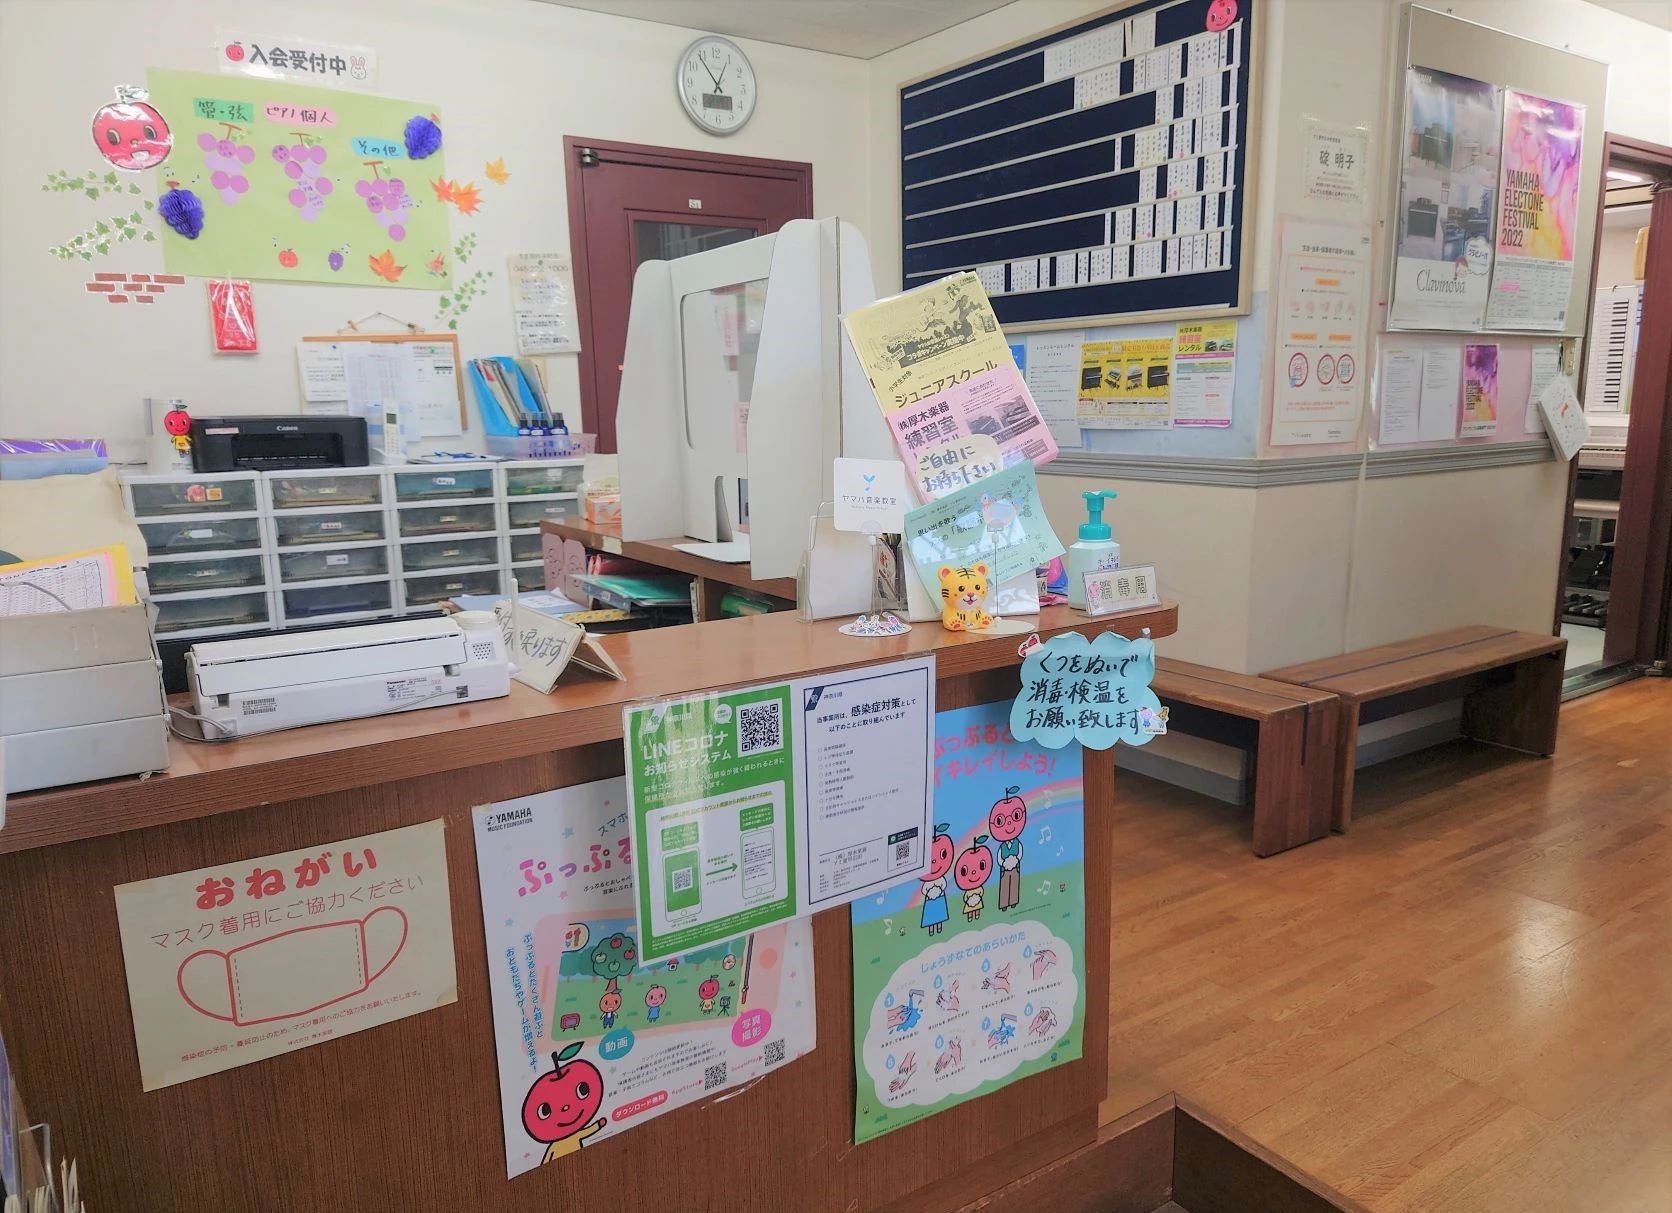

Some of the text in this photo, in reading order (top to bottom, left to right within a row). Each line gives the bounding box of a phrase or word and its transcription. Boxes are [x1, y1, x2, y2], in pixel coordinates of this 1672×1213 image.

[248, 42, 348, 77] 入会受付中
[357, 139, 399, 157] その他
[1335, 153, 1354, 169] 明子
[1506, 168, 1540, 192] YAMAHA
[1504, 189, 1544, 213] ELECTONE
[1502, 209, 1539, 230] FESTIVAL
[1501, 228, 1523, 248] 2022
[1416, 269, 1466, 295] Clavinova
[1178, 344, 1201, 352] レンタル
[889, 370, 913, 392] 小学生対象
[895, 360, 998, 408] ジュニアスクール
[276, 425, 299, 433] Canon
[905, 415, 959, 450] 練習室
[919, 444, 976, 470] ご自由に
[842, 495, 897, 505] ヤマハ音楽教室
[1039, 652, 1139, 677] くつをぬいで
[1026, 678, 1130, 705] 消毒・検温を
[817, 697, 917, 724] 当事業所は、感染症対策として
[828, 711, 906, 733] 以下のことに取り組んでいます
[1026, 705, 1140, 735] お願い致します
[643, 730, 729, 760] LINEコロナ
[644, 750, 732, 777] お知らせシステム
[487, 817, 533, 832] MUSIC FOUNDATION
[496, 807, 532, 823] YAMAHA
[518, 837, 631, 897] ぷっぷる
[195, 848, 377, 911] おねがい
[151, 875, 424, 949] マスク着用にご協力ください
[921, 931, 1026, 974] じょうずなてのあらいかた
[742, 1014, 762, 1030] 写真
[605, 1036, 629, 1054] 動画
[742, 1027, 762, 1043] 撮影
[672, 1081, 698, 1095] AppStore
[615, 1093, 665, 1119] ダウンロード無料
